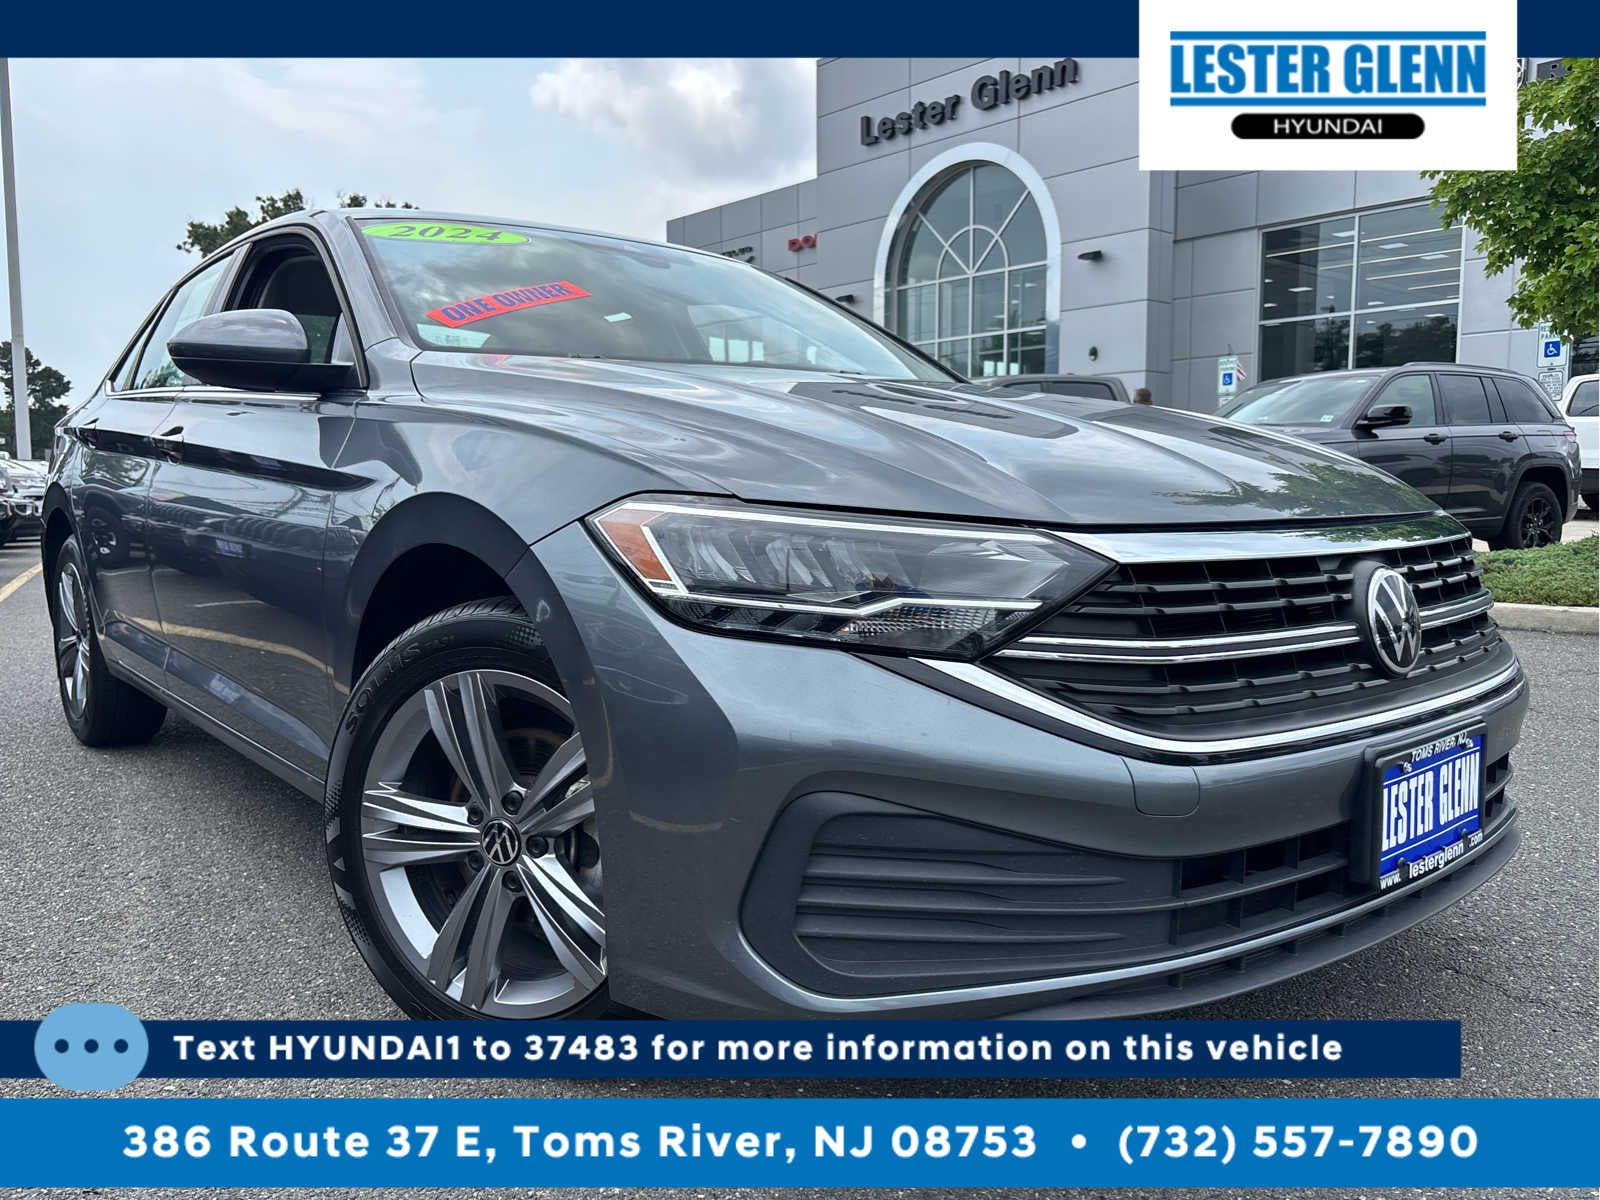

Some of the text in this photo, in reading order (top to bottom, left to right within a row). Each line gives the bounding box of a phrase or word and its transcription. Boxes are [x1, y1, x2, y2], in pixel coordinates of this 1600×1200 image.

[860, 57, 1080, 147] Lester Glenn
[391, 223, 505, 242] 2024
[441, 281, 575, 322] ONE OWNER
[1411, 745, 1434, 763] TOMS
[1456, 731, 1468, 746] NJ
[1381, 752, 1481, 852] LESTER GLENN
[1409, 842, 1464, 879] lesterglenn
